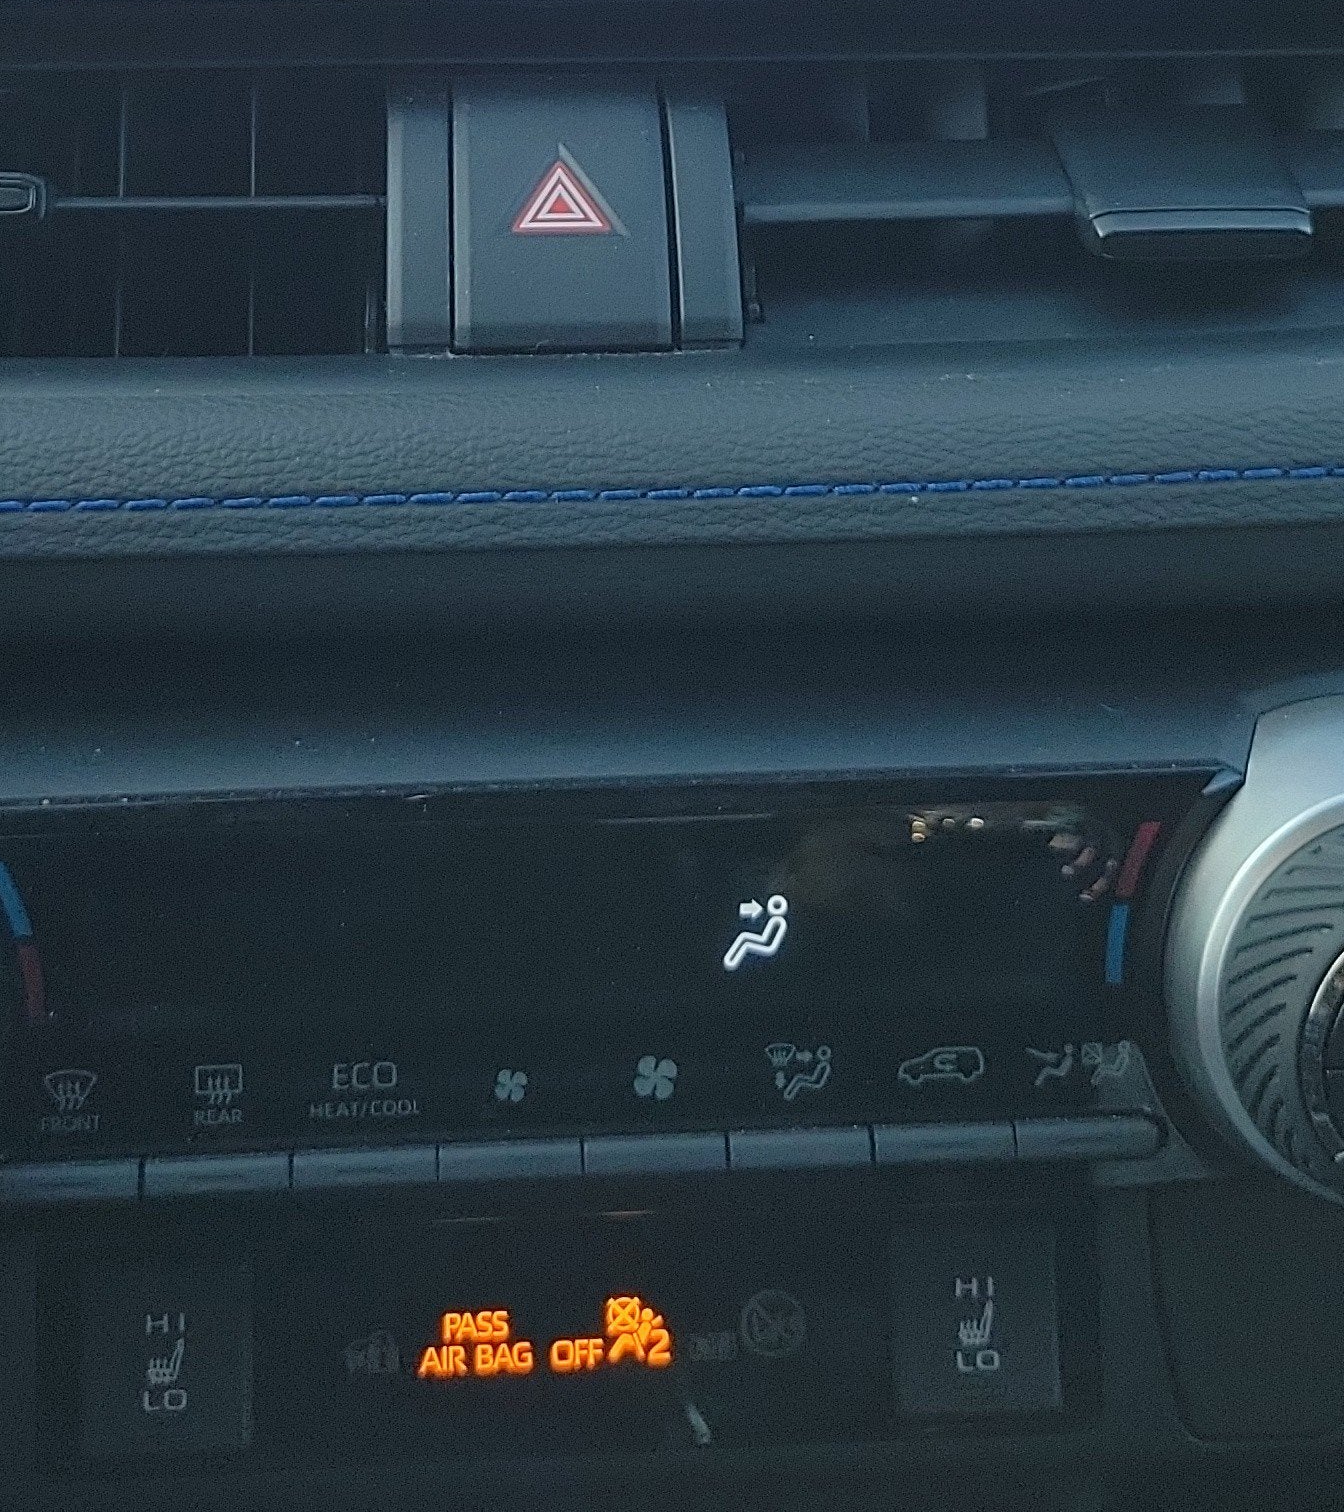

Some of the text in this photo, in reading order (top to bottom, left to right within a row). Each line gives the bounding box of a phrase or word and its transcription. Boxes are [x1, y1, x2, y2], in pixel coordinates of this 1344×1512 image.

[331, 1060, 399, 1089] ECO
[193, 1107, 244, 1126] REAR
[955, 1276, 994, 1298] HI
[145, 1312, 185, 1334] HI
[441, 1309, 510, 1343] PASS
[417, 1344, 468, 1379] AIR
[472, 1340, 535, 1375] BAG
[550, 1337, 605, 1370] OFF
[956, 1349, 1001, 1373] LO
[143, 1388, 188, 1411] LO
